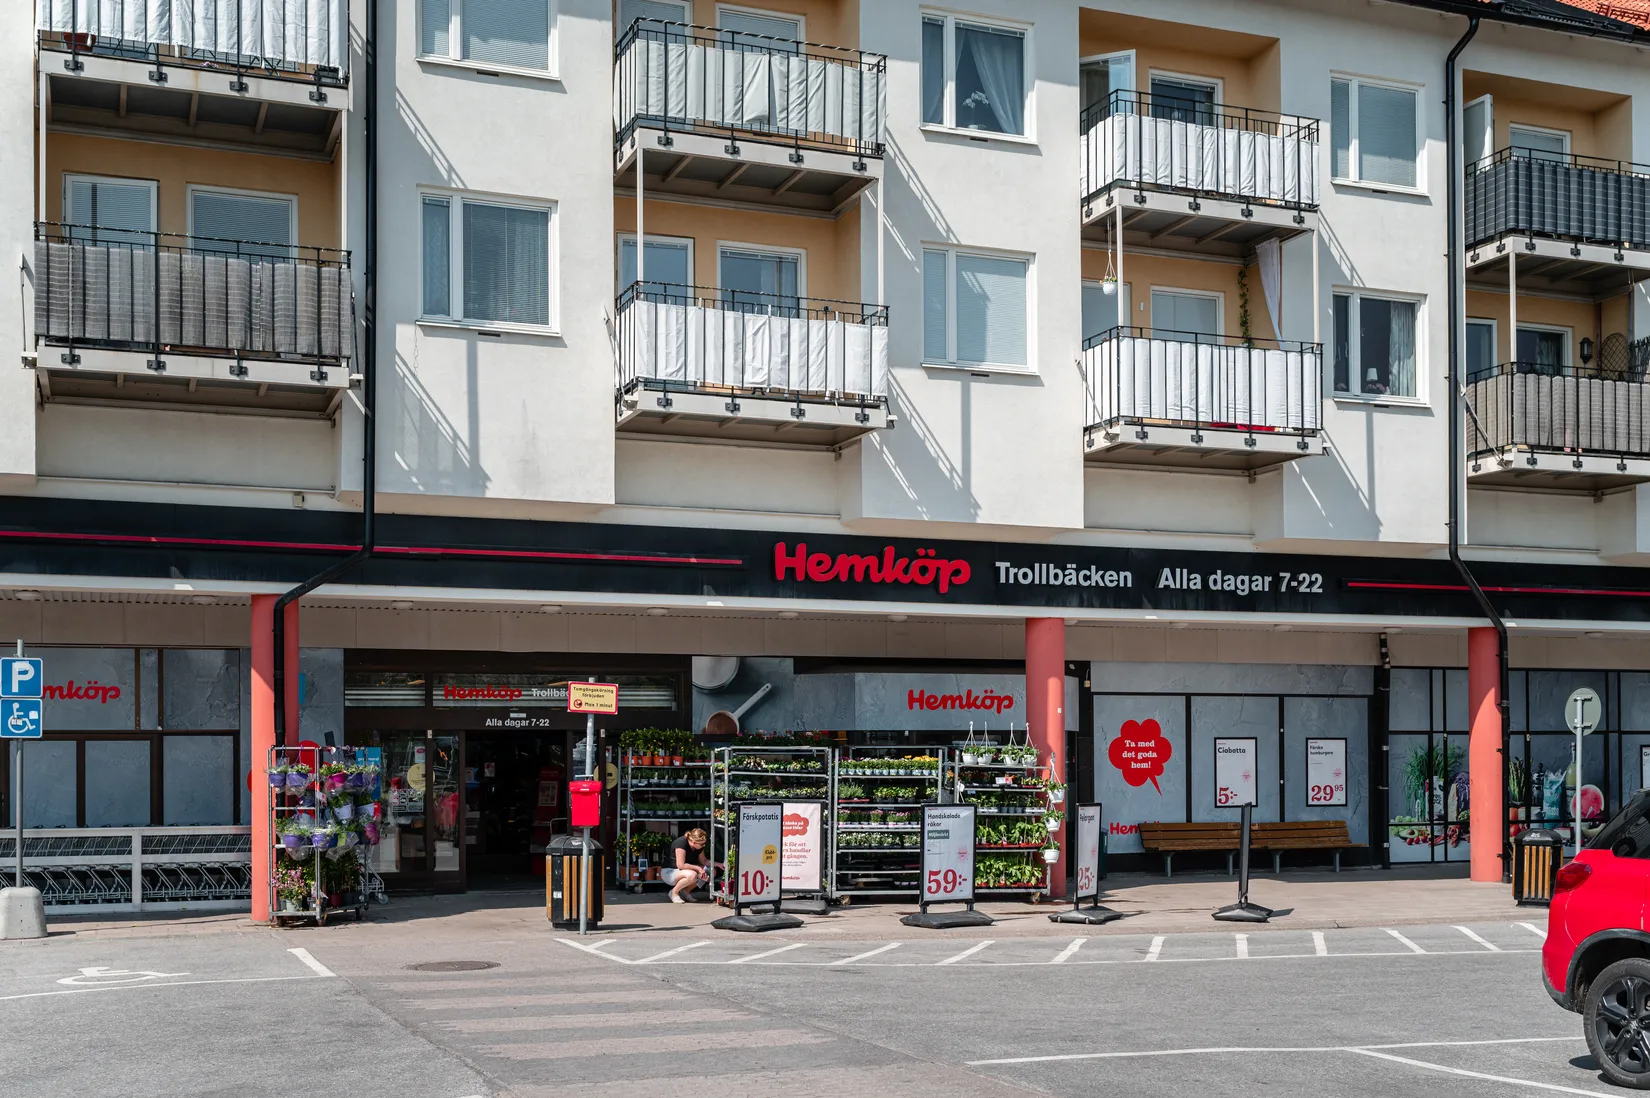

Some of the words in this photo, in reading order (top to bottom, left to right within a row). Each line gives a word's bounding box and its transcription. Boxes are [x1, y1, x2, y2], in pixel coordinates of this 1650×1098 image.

[774, 541, 971, 594] Hemköp
[996, 561, 1132, 588] Trollbäcken
[1158, 567, 1202, 590] Alla
[1209, 571, 1272, 597] dagar
[1279, 572, 1324, 593] 7-22
[11, 661, 35, 693] P
[42, 680, 121, 704] mköp
[444, 685, 522, 702] Hemköp
[532, 688, 568, 697] Trollbä
[573, 686, 614, 694] Tomgångskörning
[907, 689, 1014, 714] Hemköp
[485, 718, 502, 726] Alla
[504, 718, 529, 728] dagar
[531, 719, 550, 727] 7-22
[1122, 750, 1136, 758] det
[1137, 750, 1157, 759] goda
[1217, 746, 1246, 754] Ciabatta
[1217, 786, 1237, 804] 5:-
[743, 813, 778, 822] Färskpotatis
[927, 812, 961, 820] Handskalade
[741, 869, 774, 896] 10:-
[926, 868, 968, 895] 59:-
